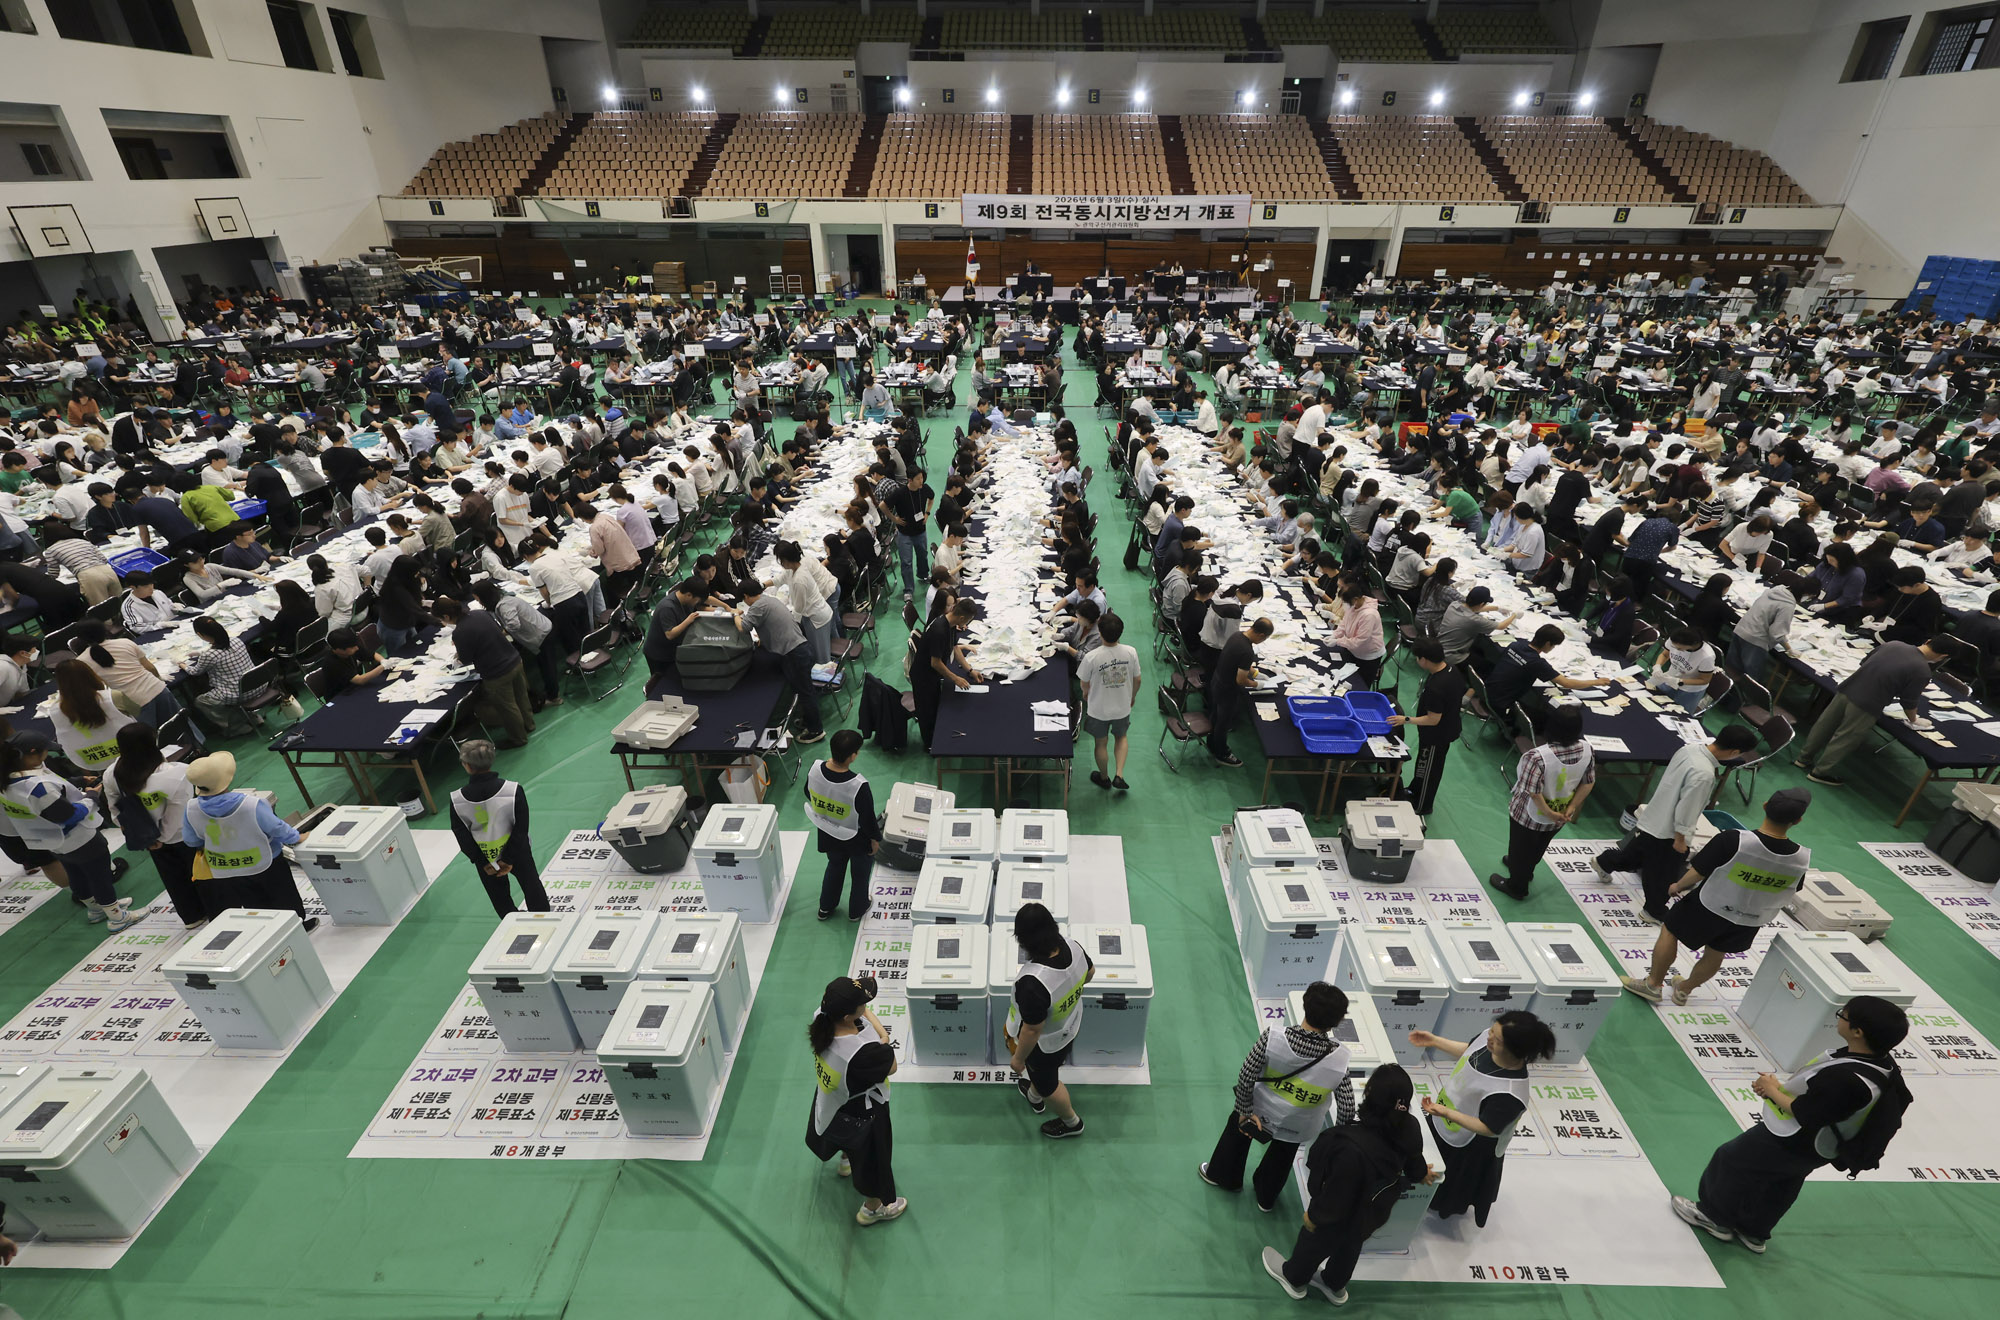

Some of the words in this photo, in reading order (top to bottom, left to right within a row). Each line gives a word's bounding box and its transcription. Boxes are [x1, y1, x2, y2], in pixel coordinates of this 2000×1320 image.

[1054, 196, 1087, 204] 2026년
[1089, 196, 1104, 204] 6월
[1107, 196, 1139, 204] 3일(수)
[1141, 196, 1159, 204] 실시
[435, 203, 439, 214] I
[588, 205, 598, 216] H
[757, 206, 766, 216] G
[928, 207, 935, 217] F
[977, 204, 1027, 221] 제9회
[1035, 204, 1191, 221] 전국동시지방선거
[1198, 204, 1236, 221] 개표
[1265, 208, 1274, 218] D
[1442, 209, 1451, 220] C
[1617, 212, 1626, 221] B
[1732, 212, 1741, 222] A
[87, 747, 120, 761] 개표참
[561, 848, 612, 860] 은천동
[1875, 850, 1930, 858] 관내사전
[208, 856, 254, 866] 개표참관
[1556, 861, 1592, 873] 행운
[1898, 864, 1953, 877] 성현동
[1737, 871, 1787, 887] 개표참관
[564, 880, 592, 890] 교부
[607, 881, 628, 890] 1차
[629, 880, 656, 891] 교부
[671, 881, 693, 890] 1차
[875, 886, 898, 895] 2차
[672, 896, 704, 904] 삼성동
[1363, 892, 1387, 902] 2차
[1388, 892, 1416, 902] 교부
[1429, 893, 1453, 902] 2차
[1454, 893, 1482, 903] 교부
[1578, 893, 1604, 903] 2차
[1607, 893, 1633, 904] 교부
[1934, 897, 1962, 906] 2차
[1960, 897, 1991, 907] 교부
[870, 912, 912, 920] 제1투표
[1382, 907, 1414, 916] 서원동
[1449, 908, 1481, 917] 서원동
[1600, 909, 1635, 918] 조원동
[1965, 912, 2000, 920] 신사동
[1376, 917, 1427, 925] 제3투표소
[1598, 919, 1653, 927] 제1투표소
[1966, 922, 2000, 930] 제1투
[113, 935, 137, 945] 1차
[138, 935, 171, 946] 교부
[865, 941, 887, 951] 1차
[103, 952, 143, 962] 난곡동
[1280, 956, 1315, 964] 투표함
[1619, 949, 1647, 960] 2차
[80, 963, 137, 973] 제5투표소
[864, 958, 909, 968] 낙성대동
[1715, 978, 1750, 988] 제2투
[36, 997, 65, 1009] 2차
[64, 997, 102, 1010] 교부
[110, 998, 140, 1009] 2차
[140, 997, 176, 1011] 교부
[1058, 985, 1083, 1013] 개표참
[204, 1006, 242, 1015] 투표함
[503, 1009, 541, 1018] 투표함
[876, 1004, 907, 1017] 교부
[1263, 1007, 1286, 1019] 2차
[26, 1016, 69, 1027] 난곡동
[102, 1017, 145, 1028] 난곡동
[1668, 1012, 1697, 1026] 1차
[1697, 1013, 1731, 1026] 교부
[1925, 1015, 1961, 1028] 교부
[440, 1029, 499, 1040] 제1투표소
[930, 1025, 968, 1033] 투표함
[0, 1030, 62, 1041] 제1투표소
[77, 1030, 139, 1042] 제2투표소
[154, 1031, 212, 1042] 제3투표소
[1689, 1033, 1742, 1044] 보라매동
[1922, 1035, 1977, 1047] 보라매동
[1694, 1046, 1758, 1058] 제1투표소
[1930, 1049, 1997, 1060] 제4투표소
[410, 1068, 443, 1082] 2차
[442, 1067, 478, 1083] 교부
[491, 1068, 523, 1083] 2차
[522, 1068, 559, 1083] 교부
[573, 1069, 603, 1083] 2차
[409, 1091, 452, 1104] 신림동
[492, 1092, 535, 1105] 신림동
[631, 1092, 672, 1100] 투표함
[1532, 1085, 1561, 1099] 1차
[1562, 1085, 1598, 1101] 교부
[1724, 1088, 1758, 1102] 1차
[575, 1093, 615, 1105] 신림동
[387, 1108, 452, 1120] 제1투표소
[471, 1108, 536, 1121] 제2투표소
[555, 1109, 620, 1122] 제3투표소
[1559, 1109, 1600, 1123] 서원동
[1553, 1125, 1623, 1140] 제4투표소
[490, 1145, 566, 1158] 제8개함부
[1469, 1264, 1570, 1282] 제10개함부
